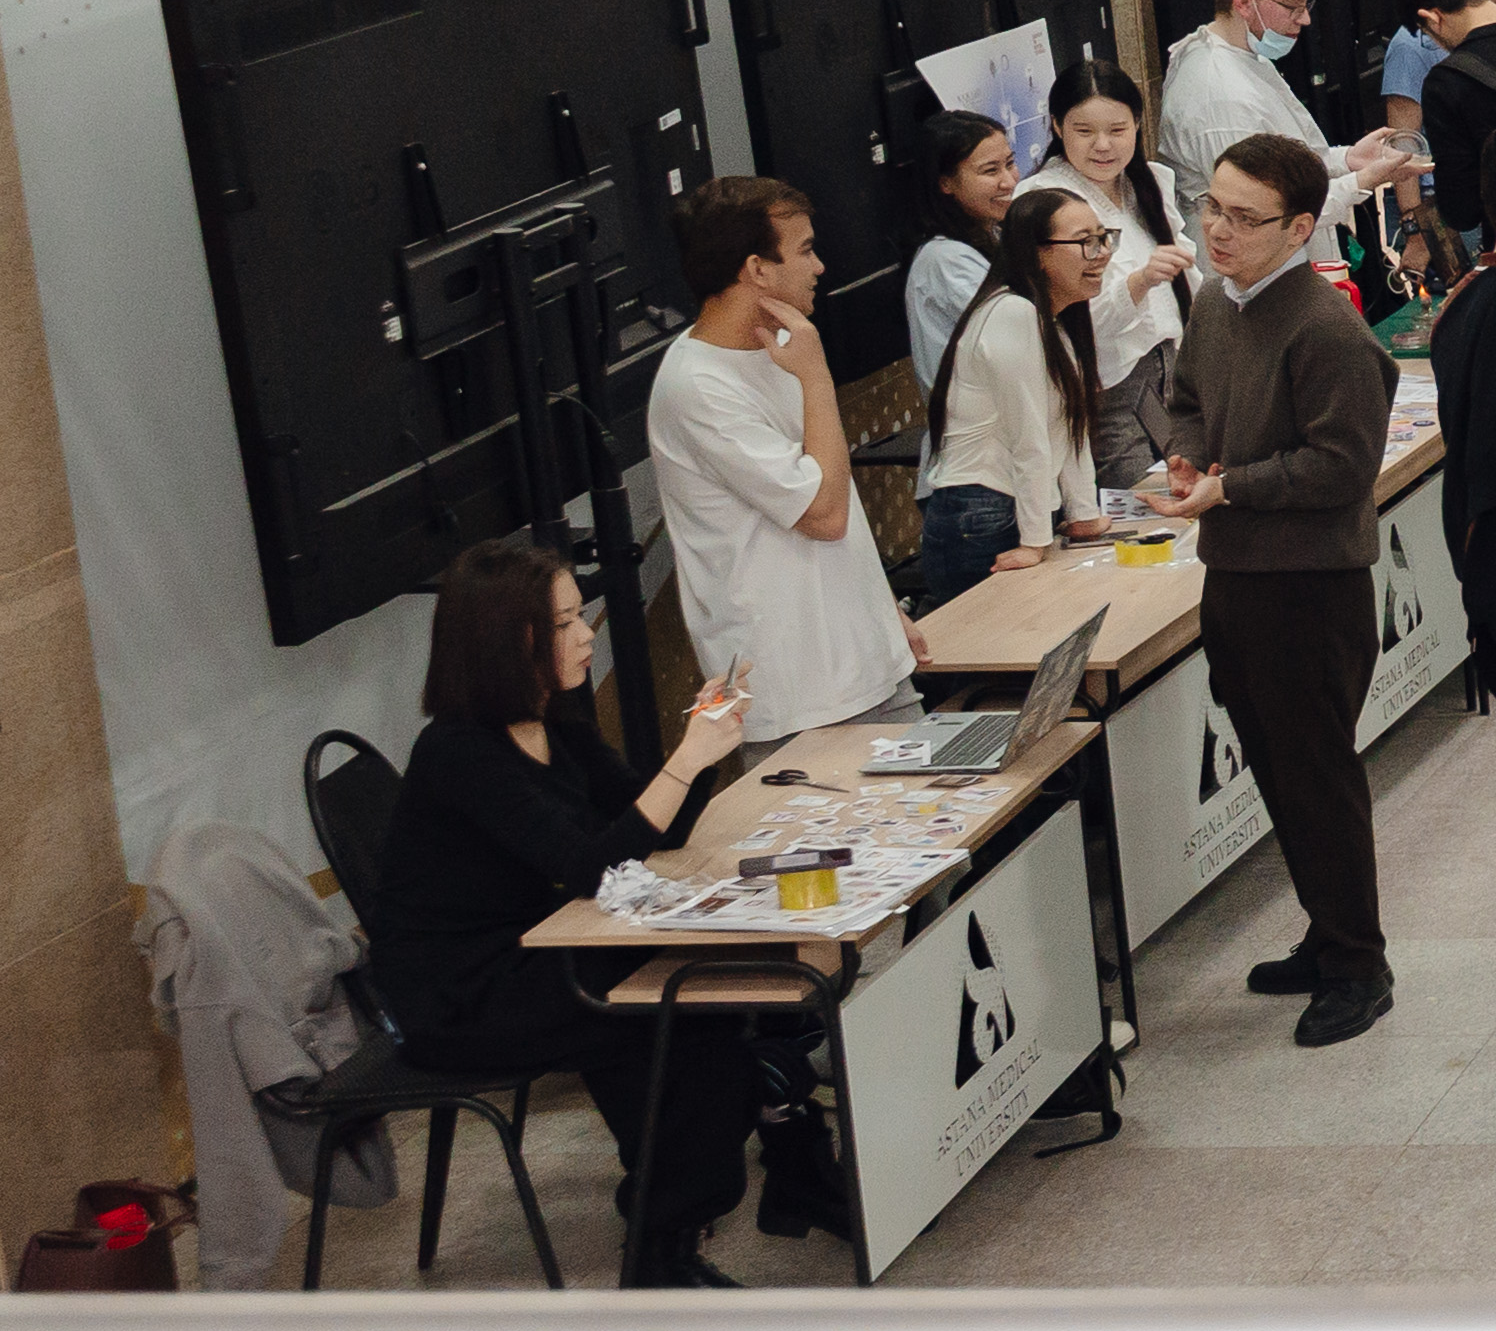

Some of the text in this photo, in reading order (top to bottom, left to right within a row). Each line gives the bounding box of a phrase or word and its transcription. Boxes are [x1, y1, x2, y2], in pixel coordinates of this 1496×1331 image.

[1369, 629, 1440, 704] ASTANA MEDICAL
[1382, 663, 1432, 720] UNIVERSITY
[1183, 784, 1261, 862] ASTANA MEDIC
[1198, 810, 1261, 879] UNIVERSITY
[937, 1038, 1042, 1162] ASTANA MEDICAL
[955, 1083, 1031, 1177] UNIVERSITY
